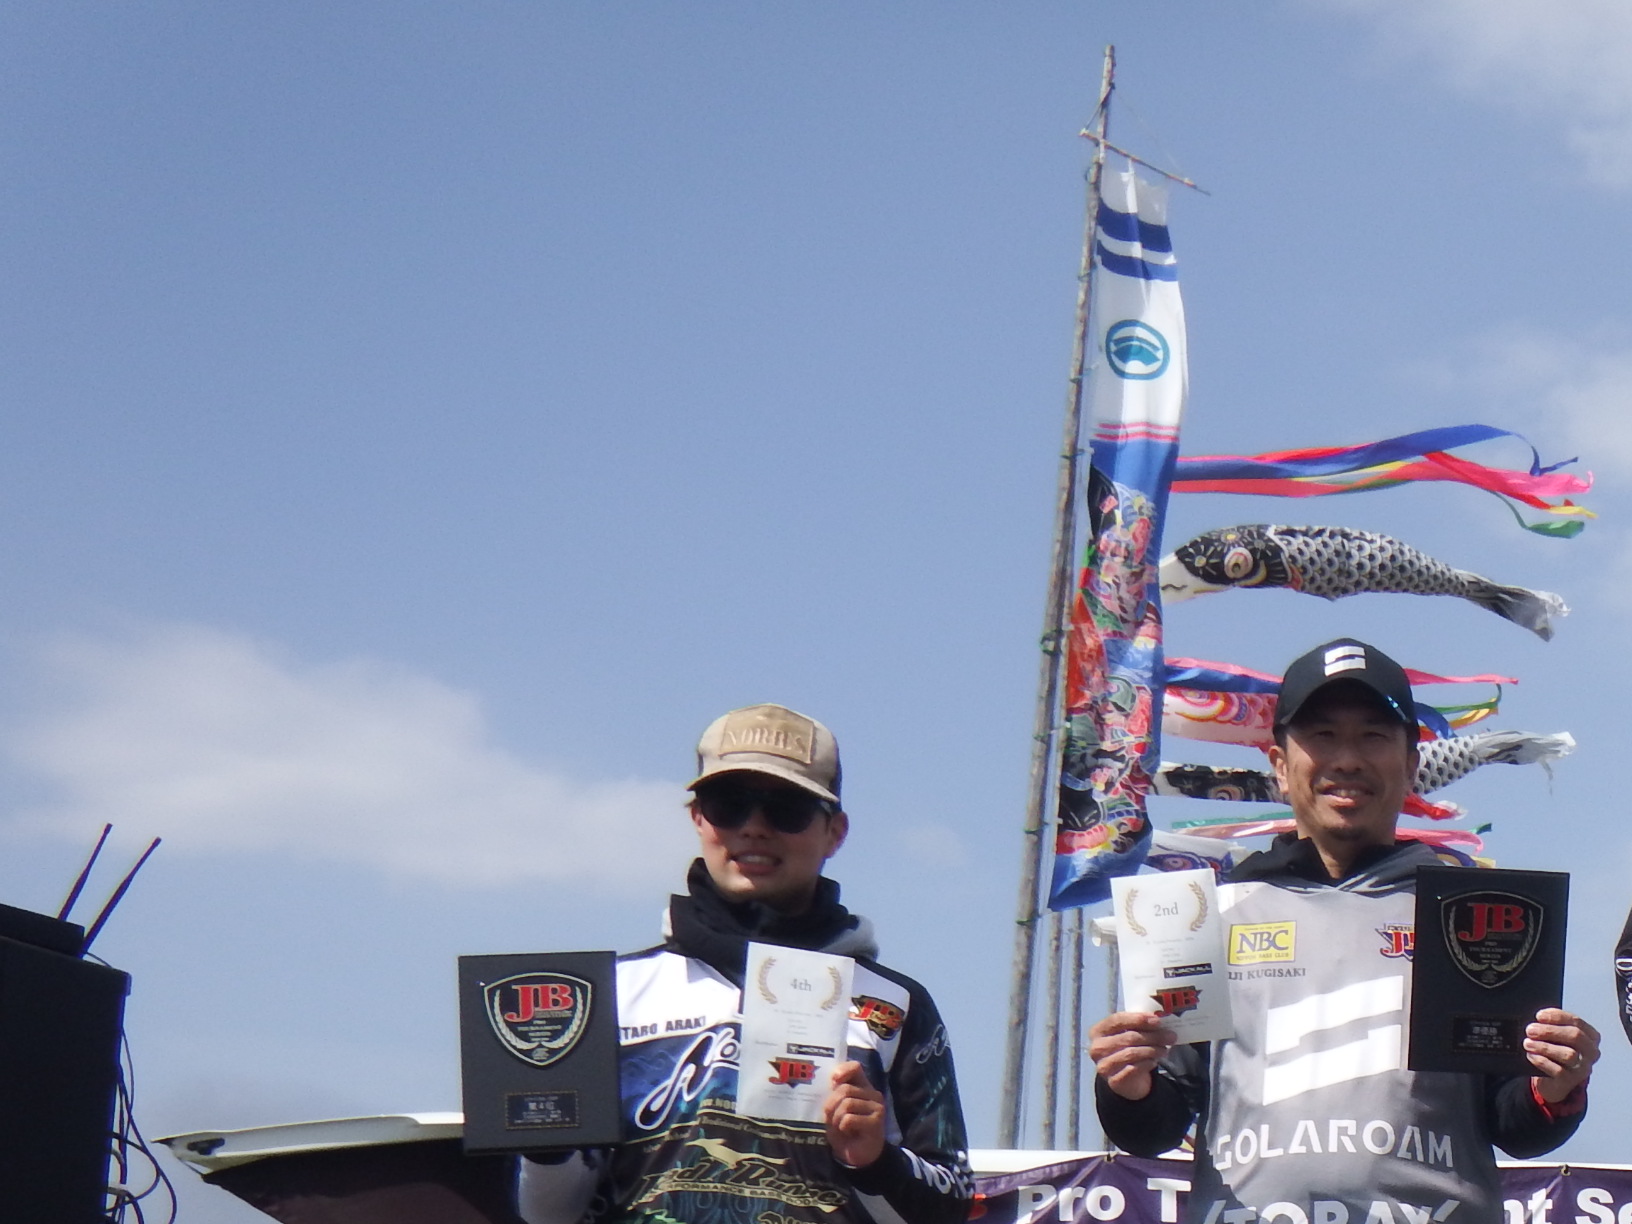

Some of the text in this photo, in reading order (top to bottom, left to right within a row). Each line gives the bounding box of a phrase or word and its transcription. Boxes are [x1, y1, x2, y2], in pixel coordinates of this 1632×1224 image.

[1153, 902, 1179, 917] 2nd
[1458, 902, 1526, 942] JB
[1236, 929, 1290, 954] NBC
[791, 978, 812, 992] 4th
[1247, 968, 1306, 980] KUGISAKI
[504, 983, 574, 1023] JB
[1154, 988, 1201, 1018] JB
[768, 1060, 816, 1086] JB
[1212, 1119, 1454, 1170] SOLAROAM
